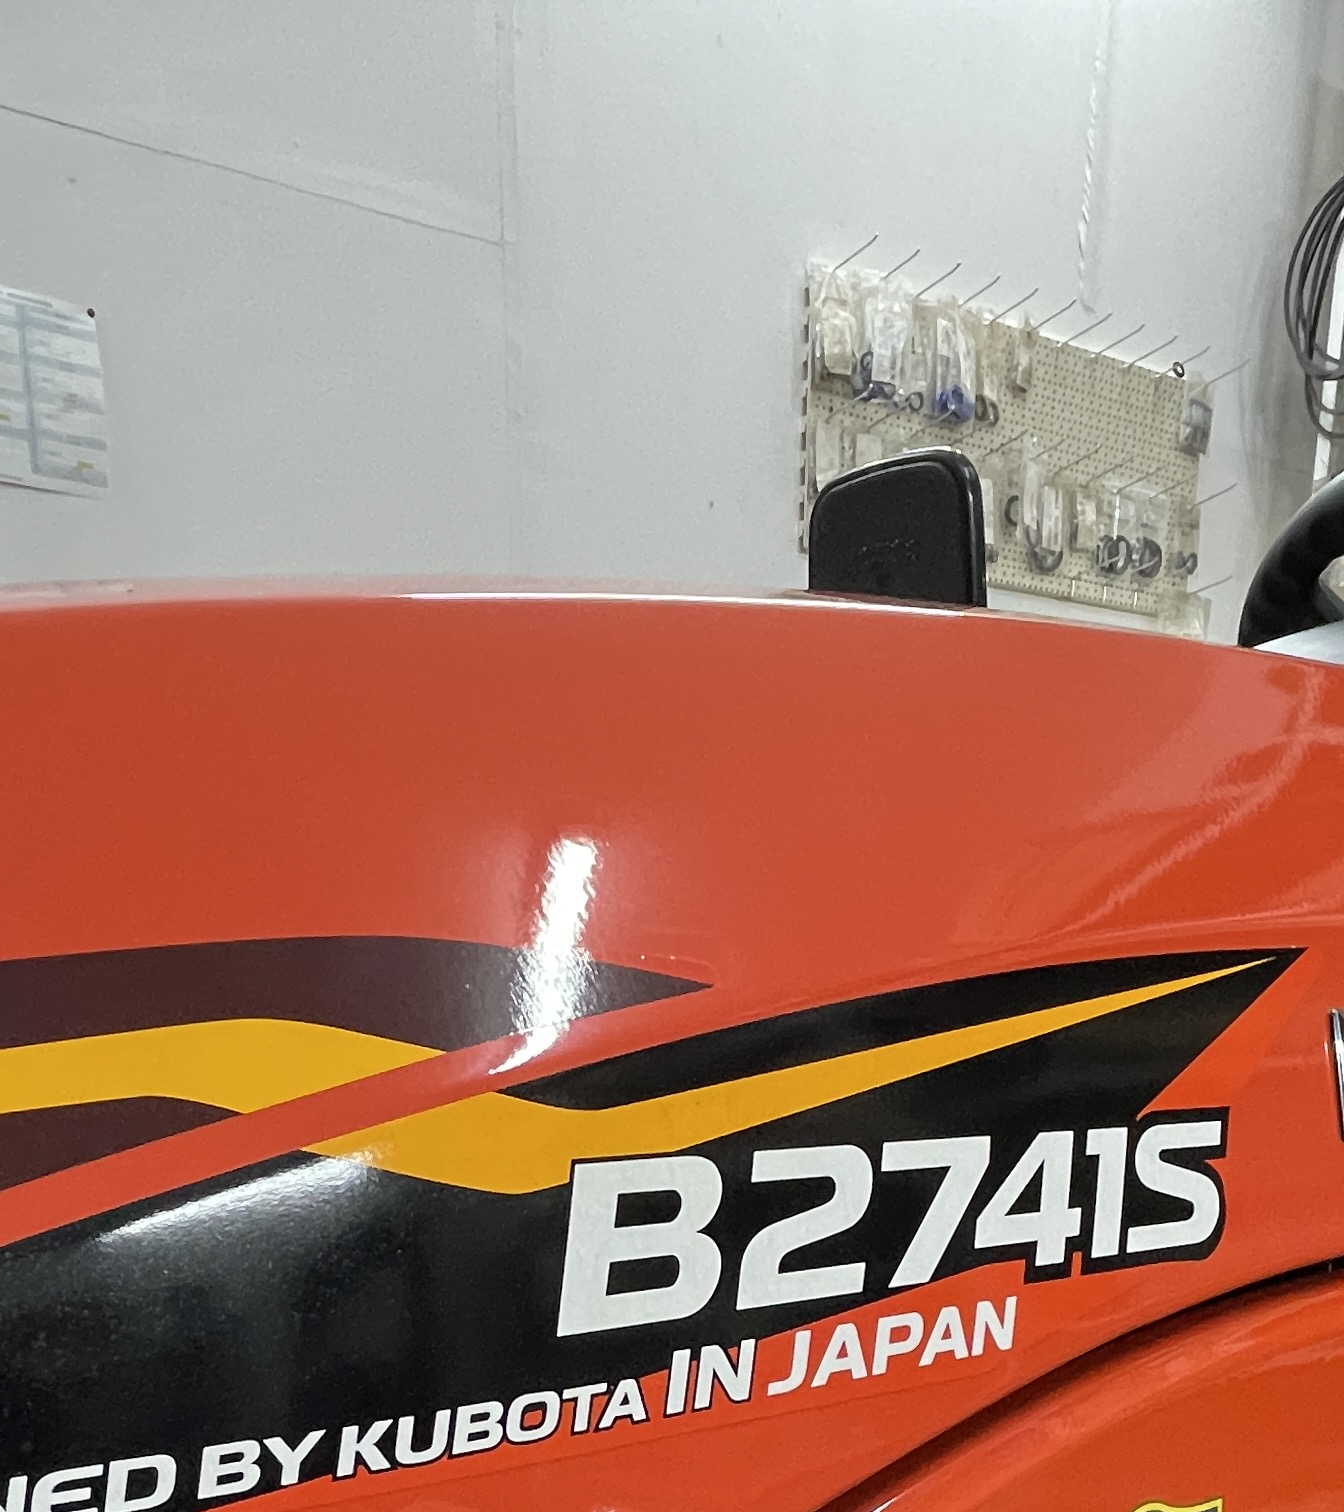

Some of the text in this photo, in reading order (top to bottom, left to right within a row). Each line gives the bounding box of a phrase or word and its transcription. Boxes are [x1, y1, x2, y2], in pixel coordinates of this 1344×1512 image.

[556, 1120, 1222, 1338] B2741S
[196, 1424, 328, 1502] BY
[336, 1377, 647, 1478] KUBOTA
[663, 1337, 756, 1415] IN
[767, 1295, 1018, 1396] JAPAN
